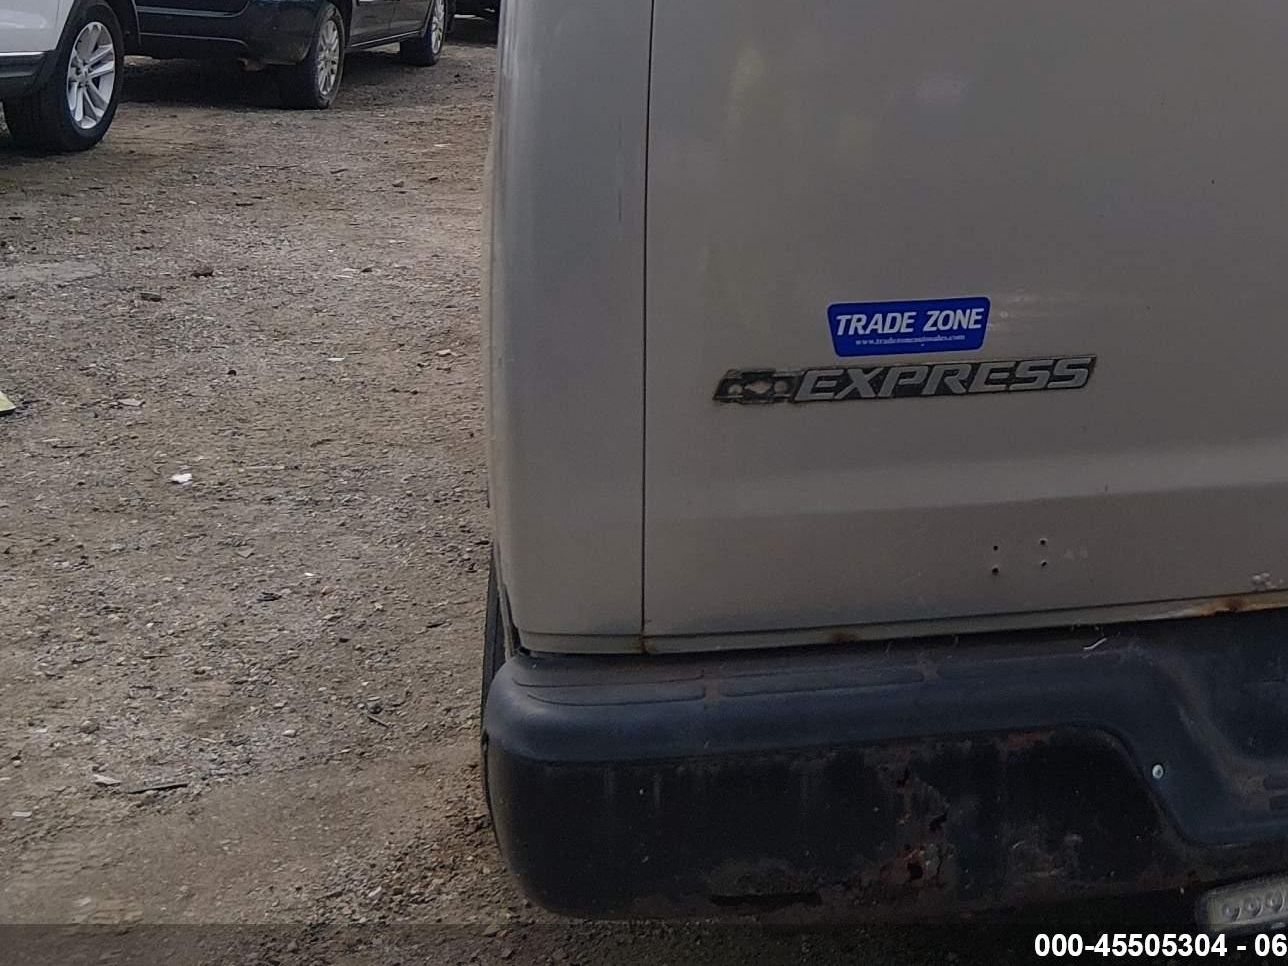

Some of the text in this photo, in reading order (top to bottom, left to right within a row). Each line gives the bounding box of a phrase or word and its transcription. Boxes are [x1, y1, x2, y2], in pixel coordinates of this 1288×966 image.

[835, 308, 985, 336] TRADE ZONE
[795, 357, 1092, 401] EXPRESS
